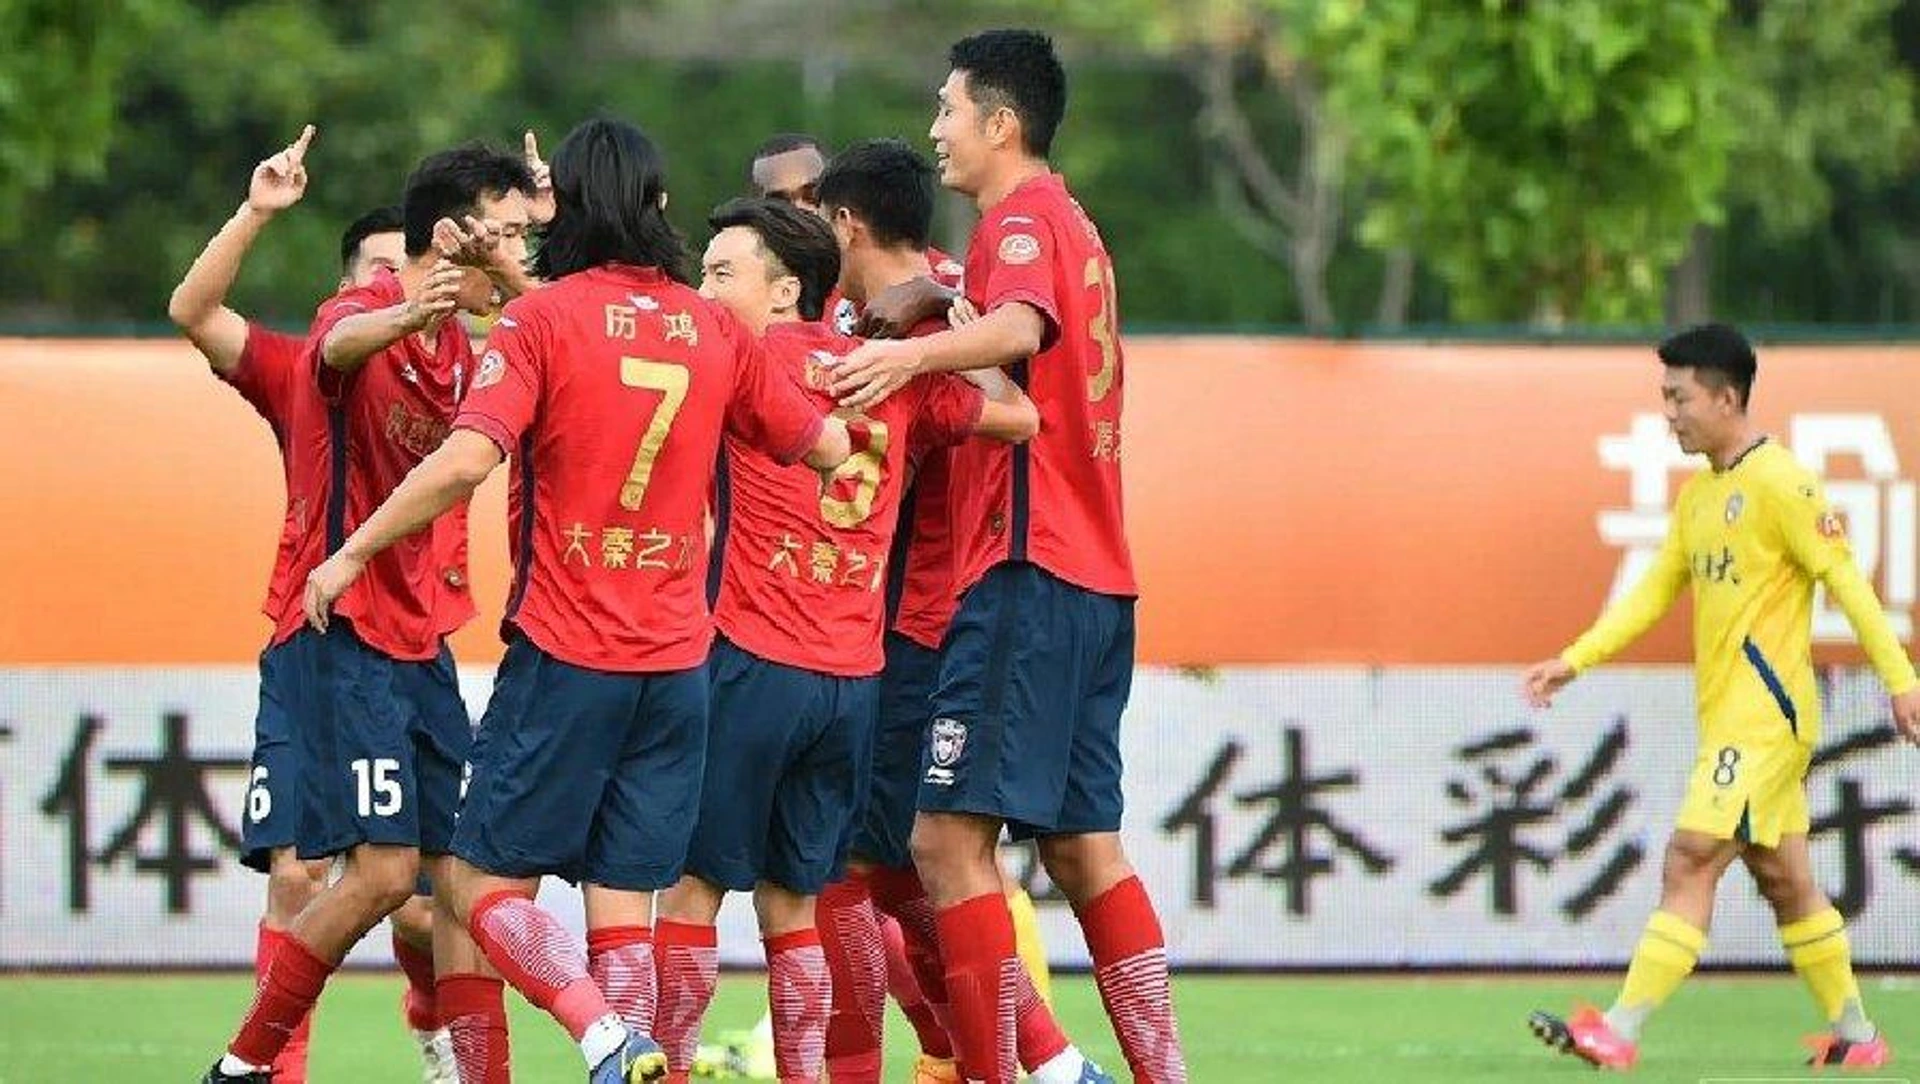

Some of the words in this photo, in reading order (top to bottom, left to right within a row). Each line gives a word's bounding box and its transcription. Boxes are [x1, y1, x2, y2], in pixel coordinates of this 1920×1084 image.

[620, 357, 690, 511] 7
[351, 758, 402, 817] 15
[1713, 746, 1741, 786] 8
